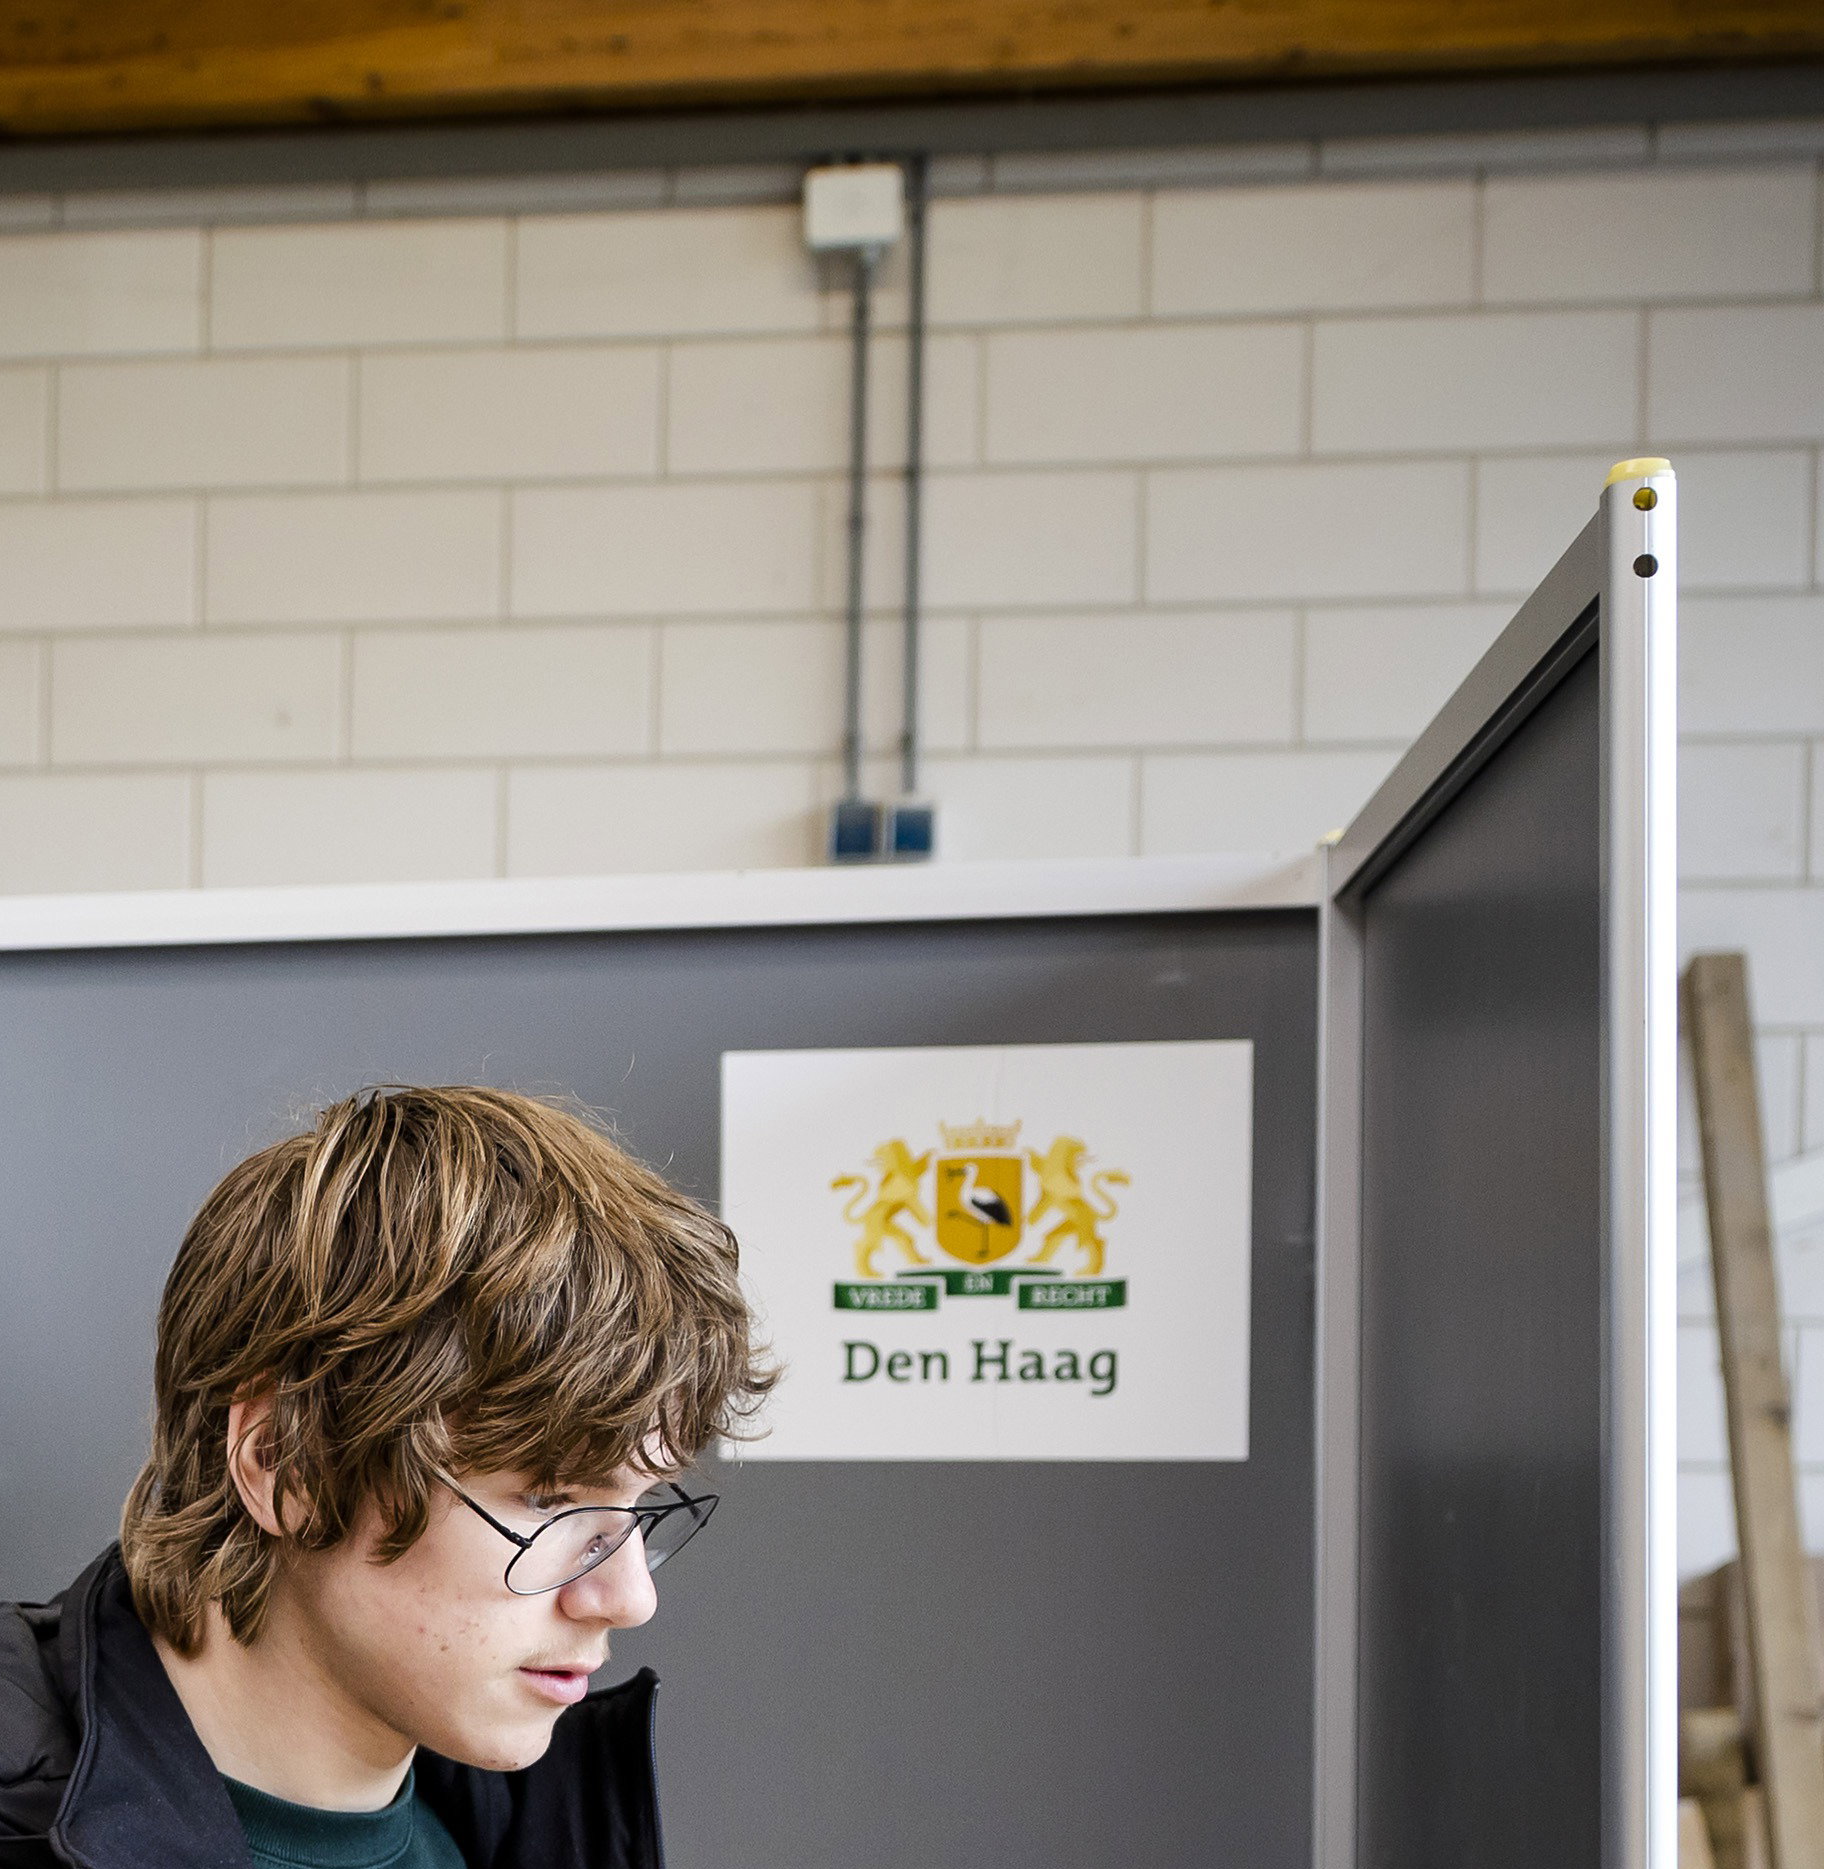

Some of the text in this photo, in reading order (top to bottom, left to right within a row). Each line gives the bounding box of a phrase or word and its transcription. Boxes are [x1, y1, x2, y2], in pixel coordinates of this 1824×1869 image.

[847, 1273, 1111, 1308] VREDE EN RECHT
[841, 1338, 1119, 1397] Den Haag
